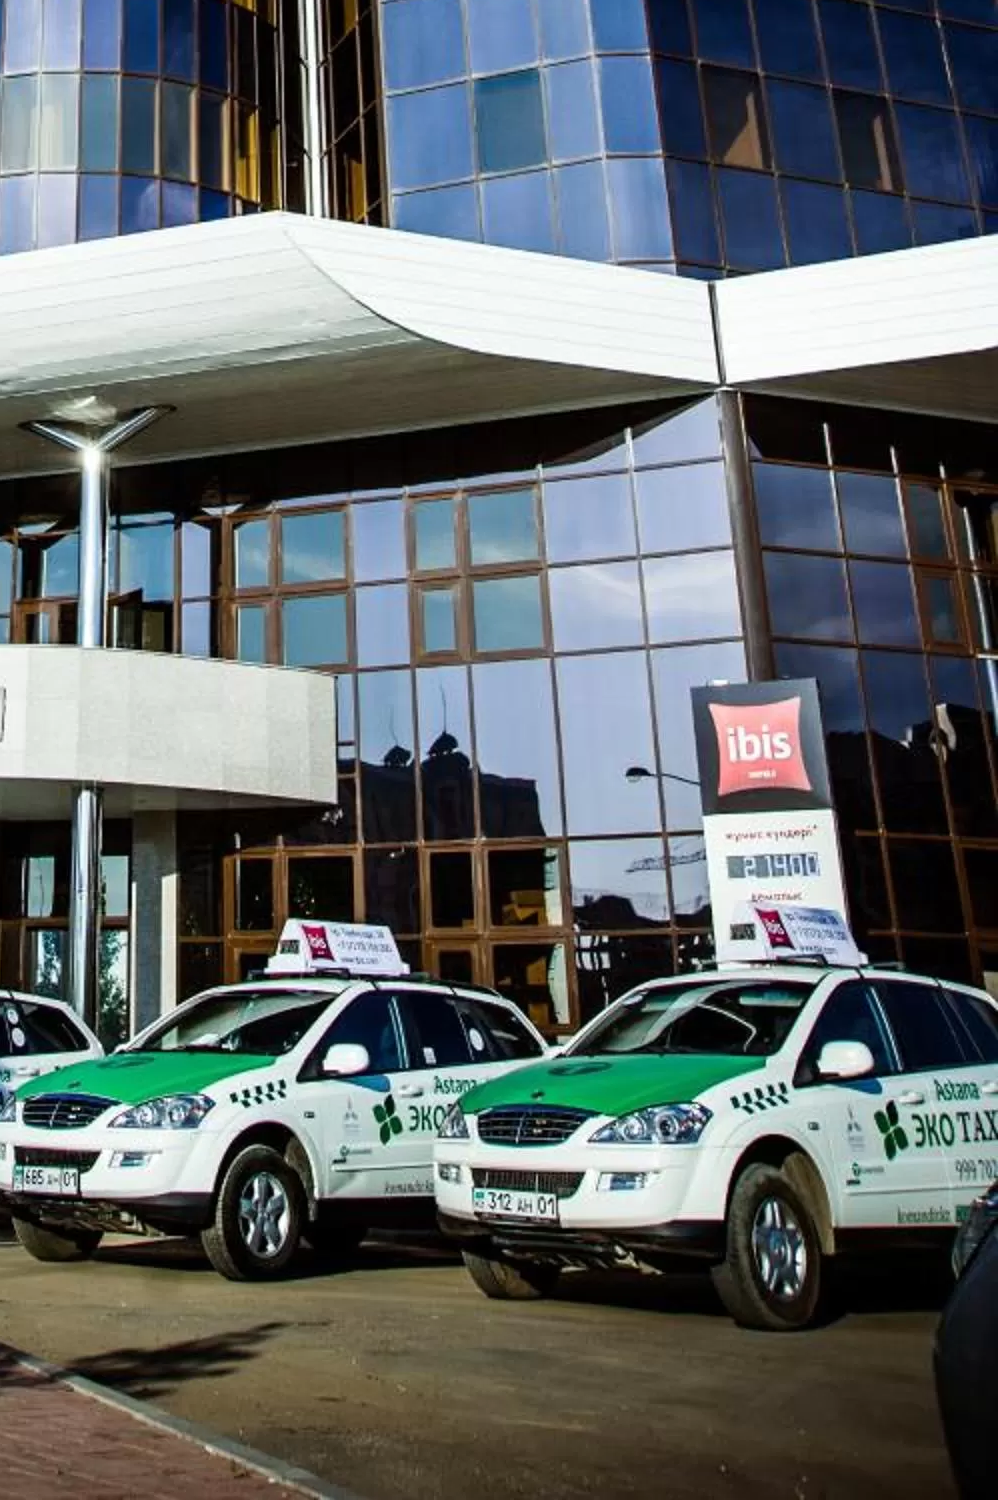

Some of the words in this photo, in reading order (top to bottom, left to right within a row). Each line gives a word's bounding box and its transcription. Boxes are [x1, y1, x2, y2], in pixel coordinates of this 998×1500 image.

[726, 724, 793, 764] ibis
[934, 1078, 980, 1101] Astana
[911, 1112, 955, 1148] ЭКО
[63, 1171, 78, 1187] 01
[955, 1159, 977, 1181] 999
[488, 1191, 513, 1211] 312
[538, 1195, 555, 1216] 01
